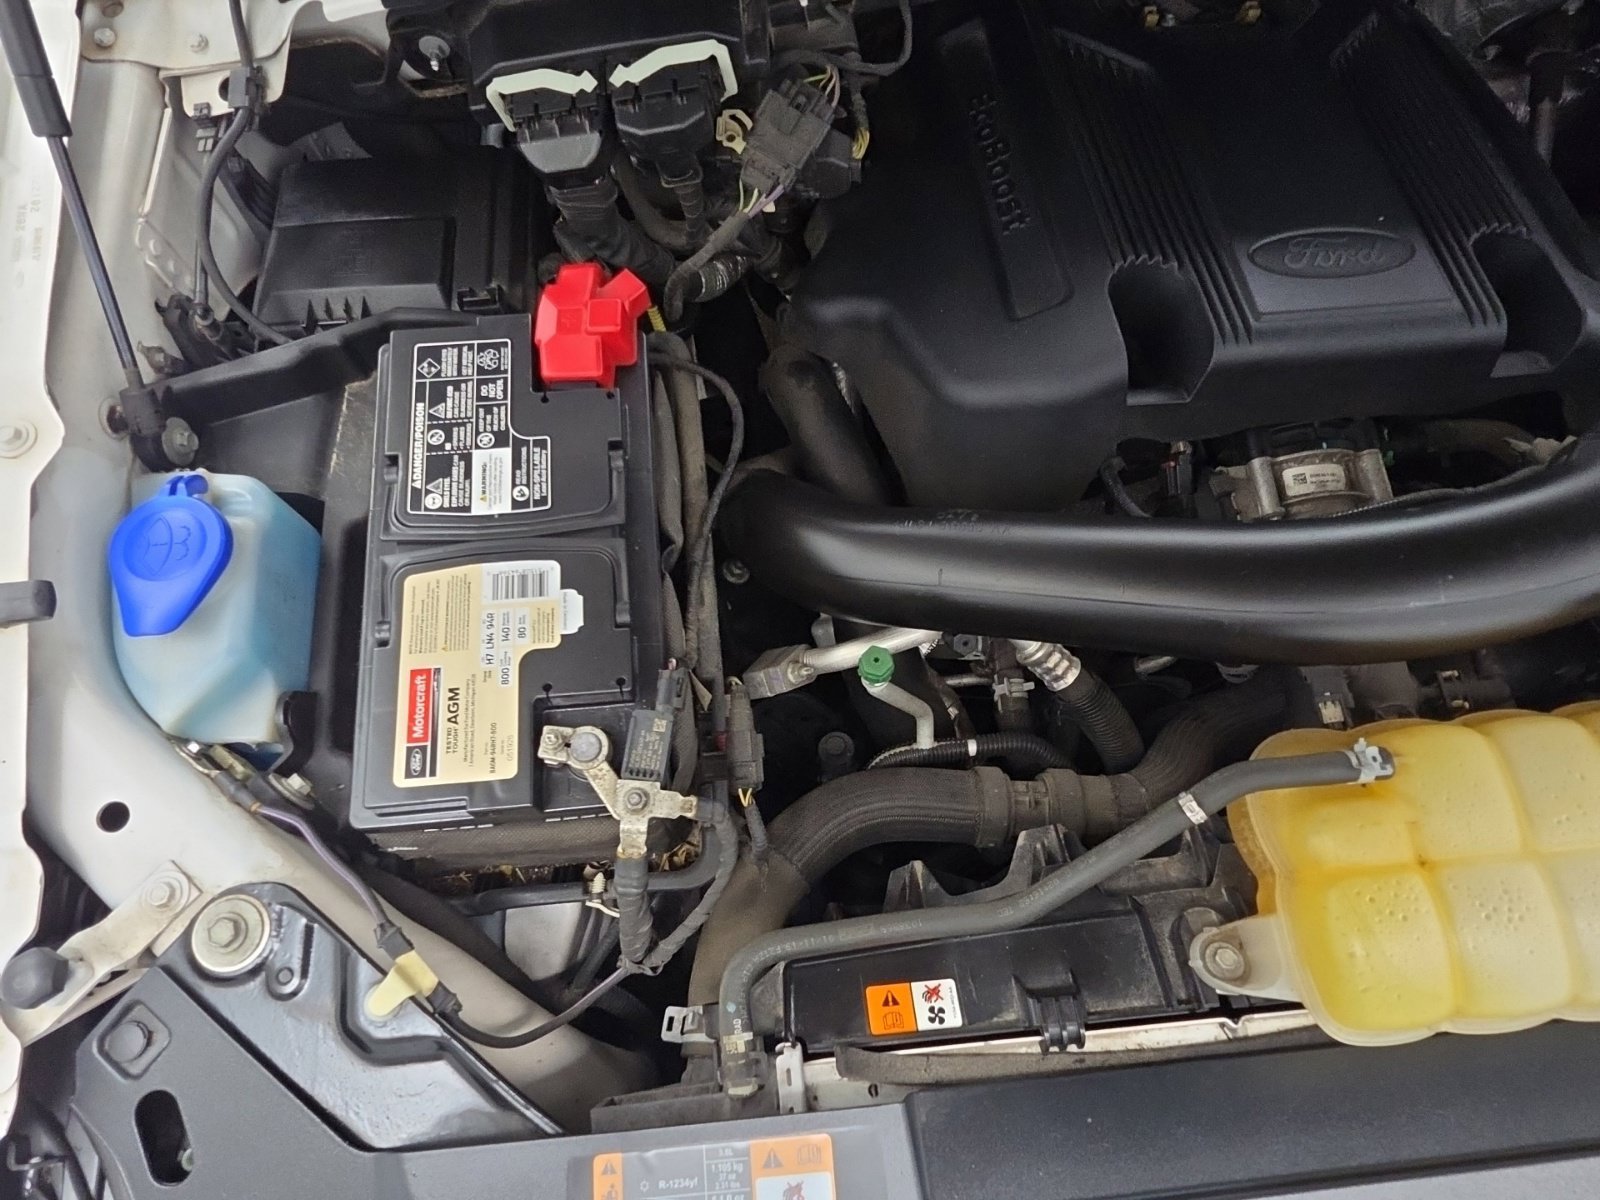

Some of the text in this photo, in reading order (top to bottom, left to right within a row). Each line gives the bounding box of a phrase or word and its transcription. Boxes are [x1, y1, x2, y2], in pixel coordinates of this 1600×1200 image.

[969, 94, 1031, 236] EcoBoost
[1283, 237, 1386, 269] Ford
[461, 383, 466, 391] OR
[481, 385, 488, 396] DO
[488, 384, 496, 397] NOT
[413, 403, 424, 480] DANGER/POISON
[486, 613, 495, 665] H7 LN4 94R
[501, 627, 510, 641] 140
[518, 627, 526, 638] 80
[501, 667, 509, 685] 800
[412, 675, 426, 738] Motorcraft
[447, 687, 460, 725] AGM
[411, 753, 421, 771] Ford
[658, 1178, 698, 1189] R-1234yf
